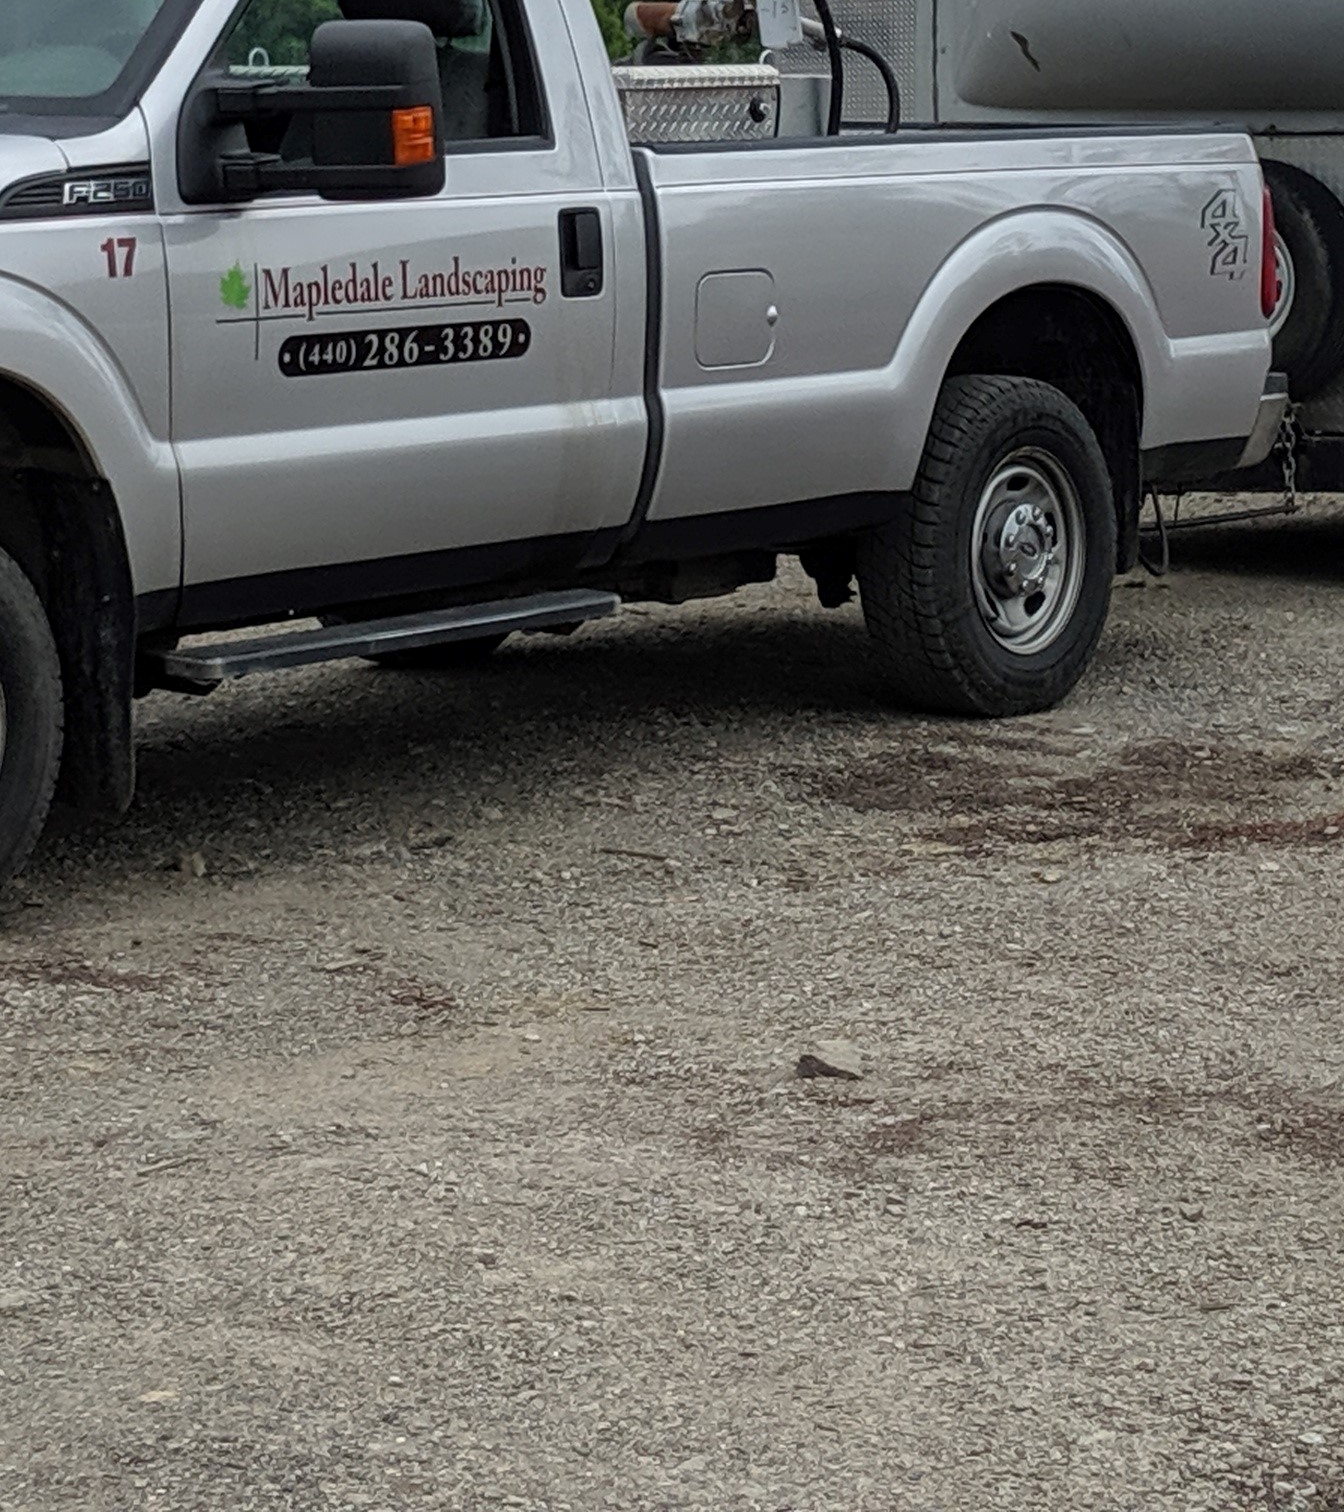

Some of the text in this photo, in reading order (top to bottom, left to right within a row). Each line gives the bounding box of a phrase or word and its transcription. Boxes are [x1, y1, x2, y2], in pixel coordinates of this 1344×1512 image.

[62, 176, 151, 205] F250
[100, 236, 137, 278] 17
[262, 256, 547, 321] Mapledale Landscaping
[298, 323, 513, 371] (440) 286-3389
